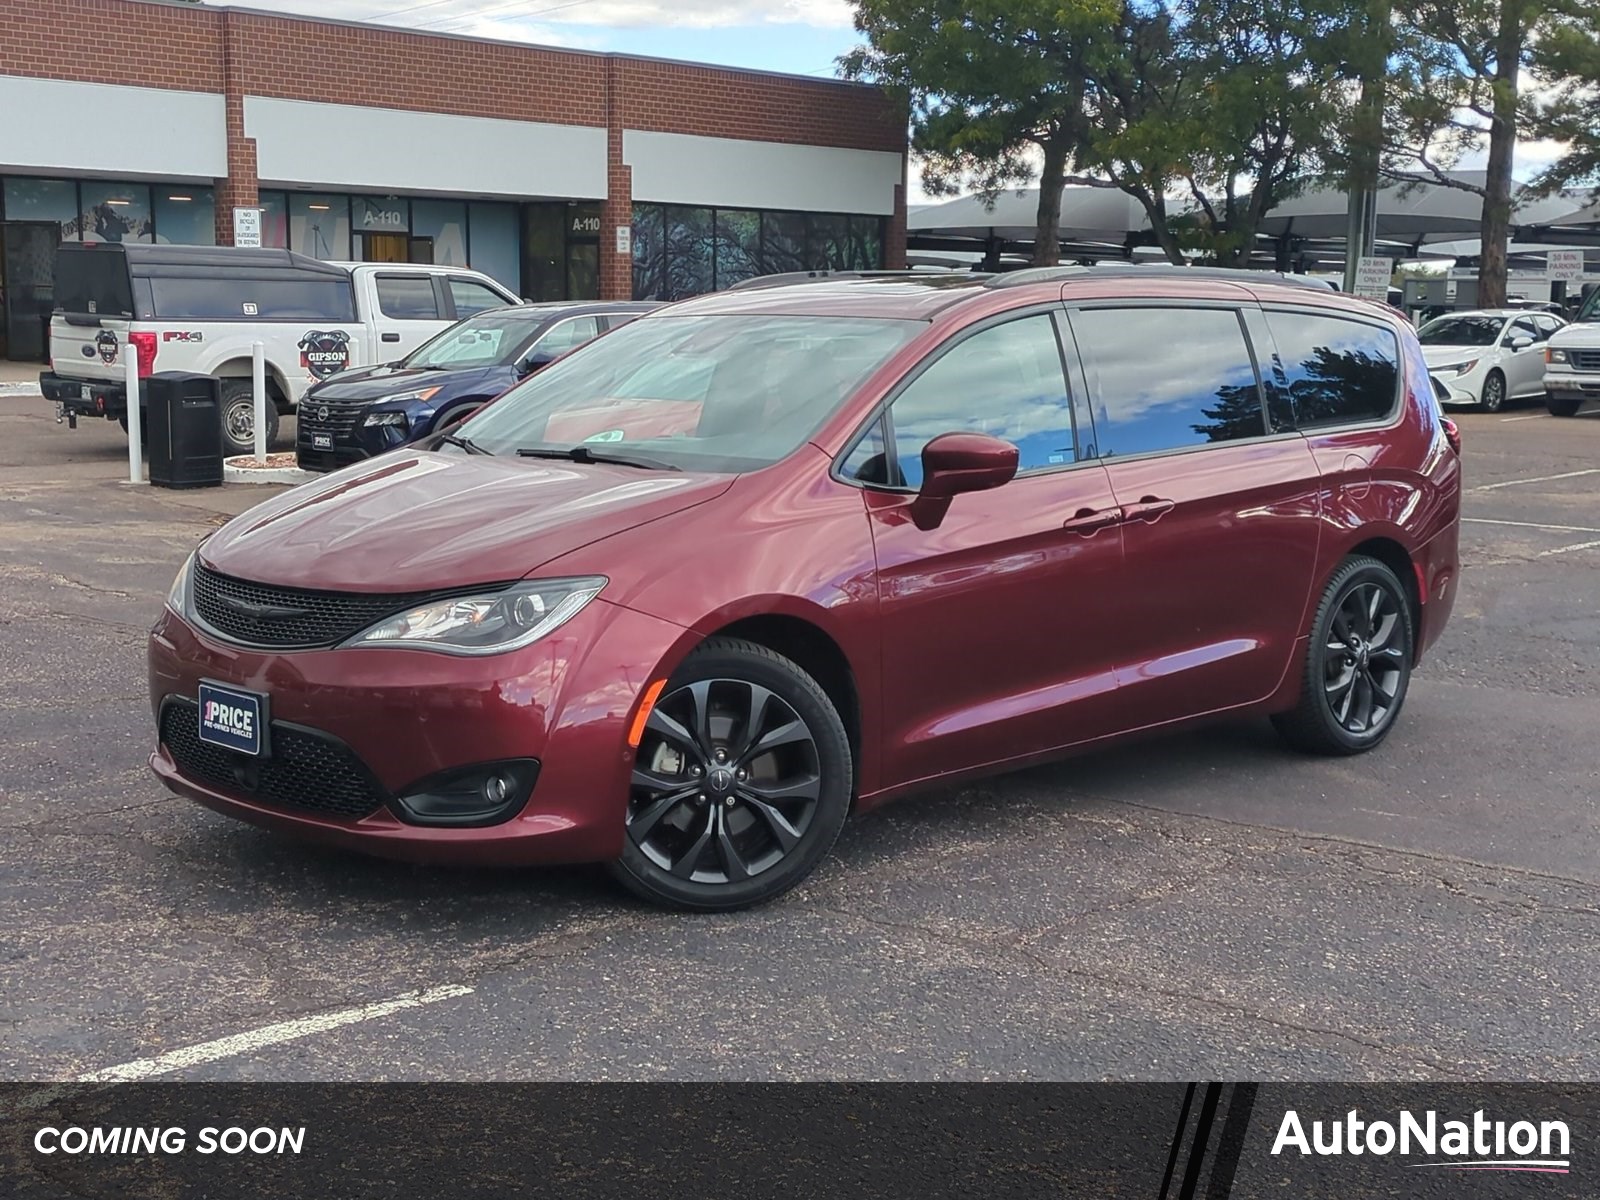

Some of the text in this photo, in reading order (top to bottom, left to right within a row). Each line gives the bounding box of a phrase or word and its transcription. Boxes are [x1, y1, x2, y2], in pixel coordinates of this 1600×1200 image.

[364, 211, 400, 224] A-110
[573, 218, 600, 230] A-110
[163, 332, 203, 342] FX4
[308, 352, 346, 361] GIPSON
[230, 727, 253, 739] VEHICLES
